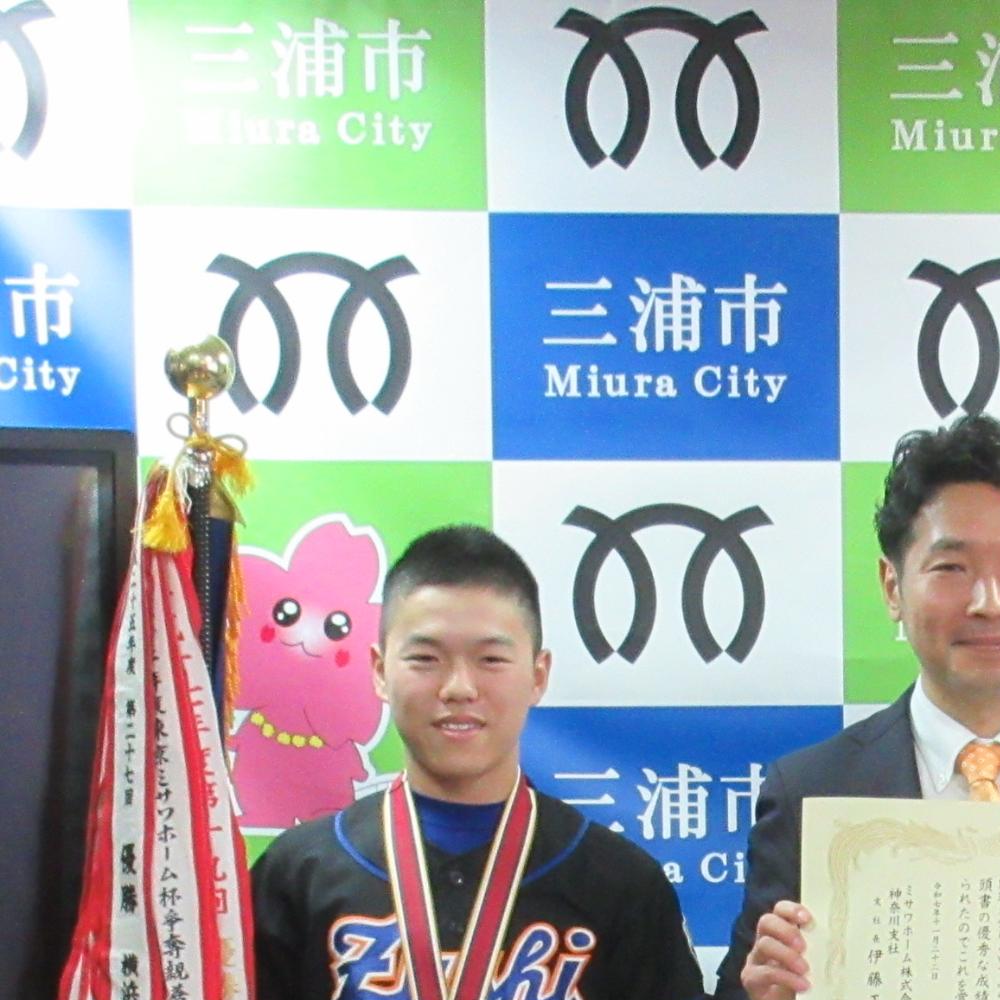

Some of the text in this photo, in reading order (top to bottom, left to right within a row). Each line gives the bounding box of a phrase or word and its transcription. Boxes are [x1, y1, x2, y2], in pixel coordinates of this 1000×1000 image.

[183, 17, 432, 99] 三浦市
[337, 112, 433, 151] City
[543, 272, 788, 353] 三浦市
[544, 364, 788, 403] Miura City
[887, 887, 902, 955] 神奈川支社
